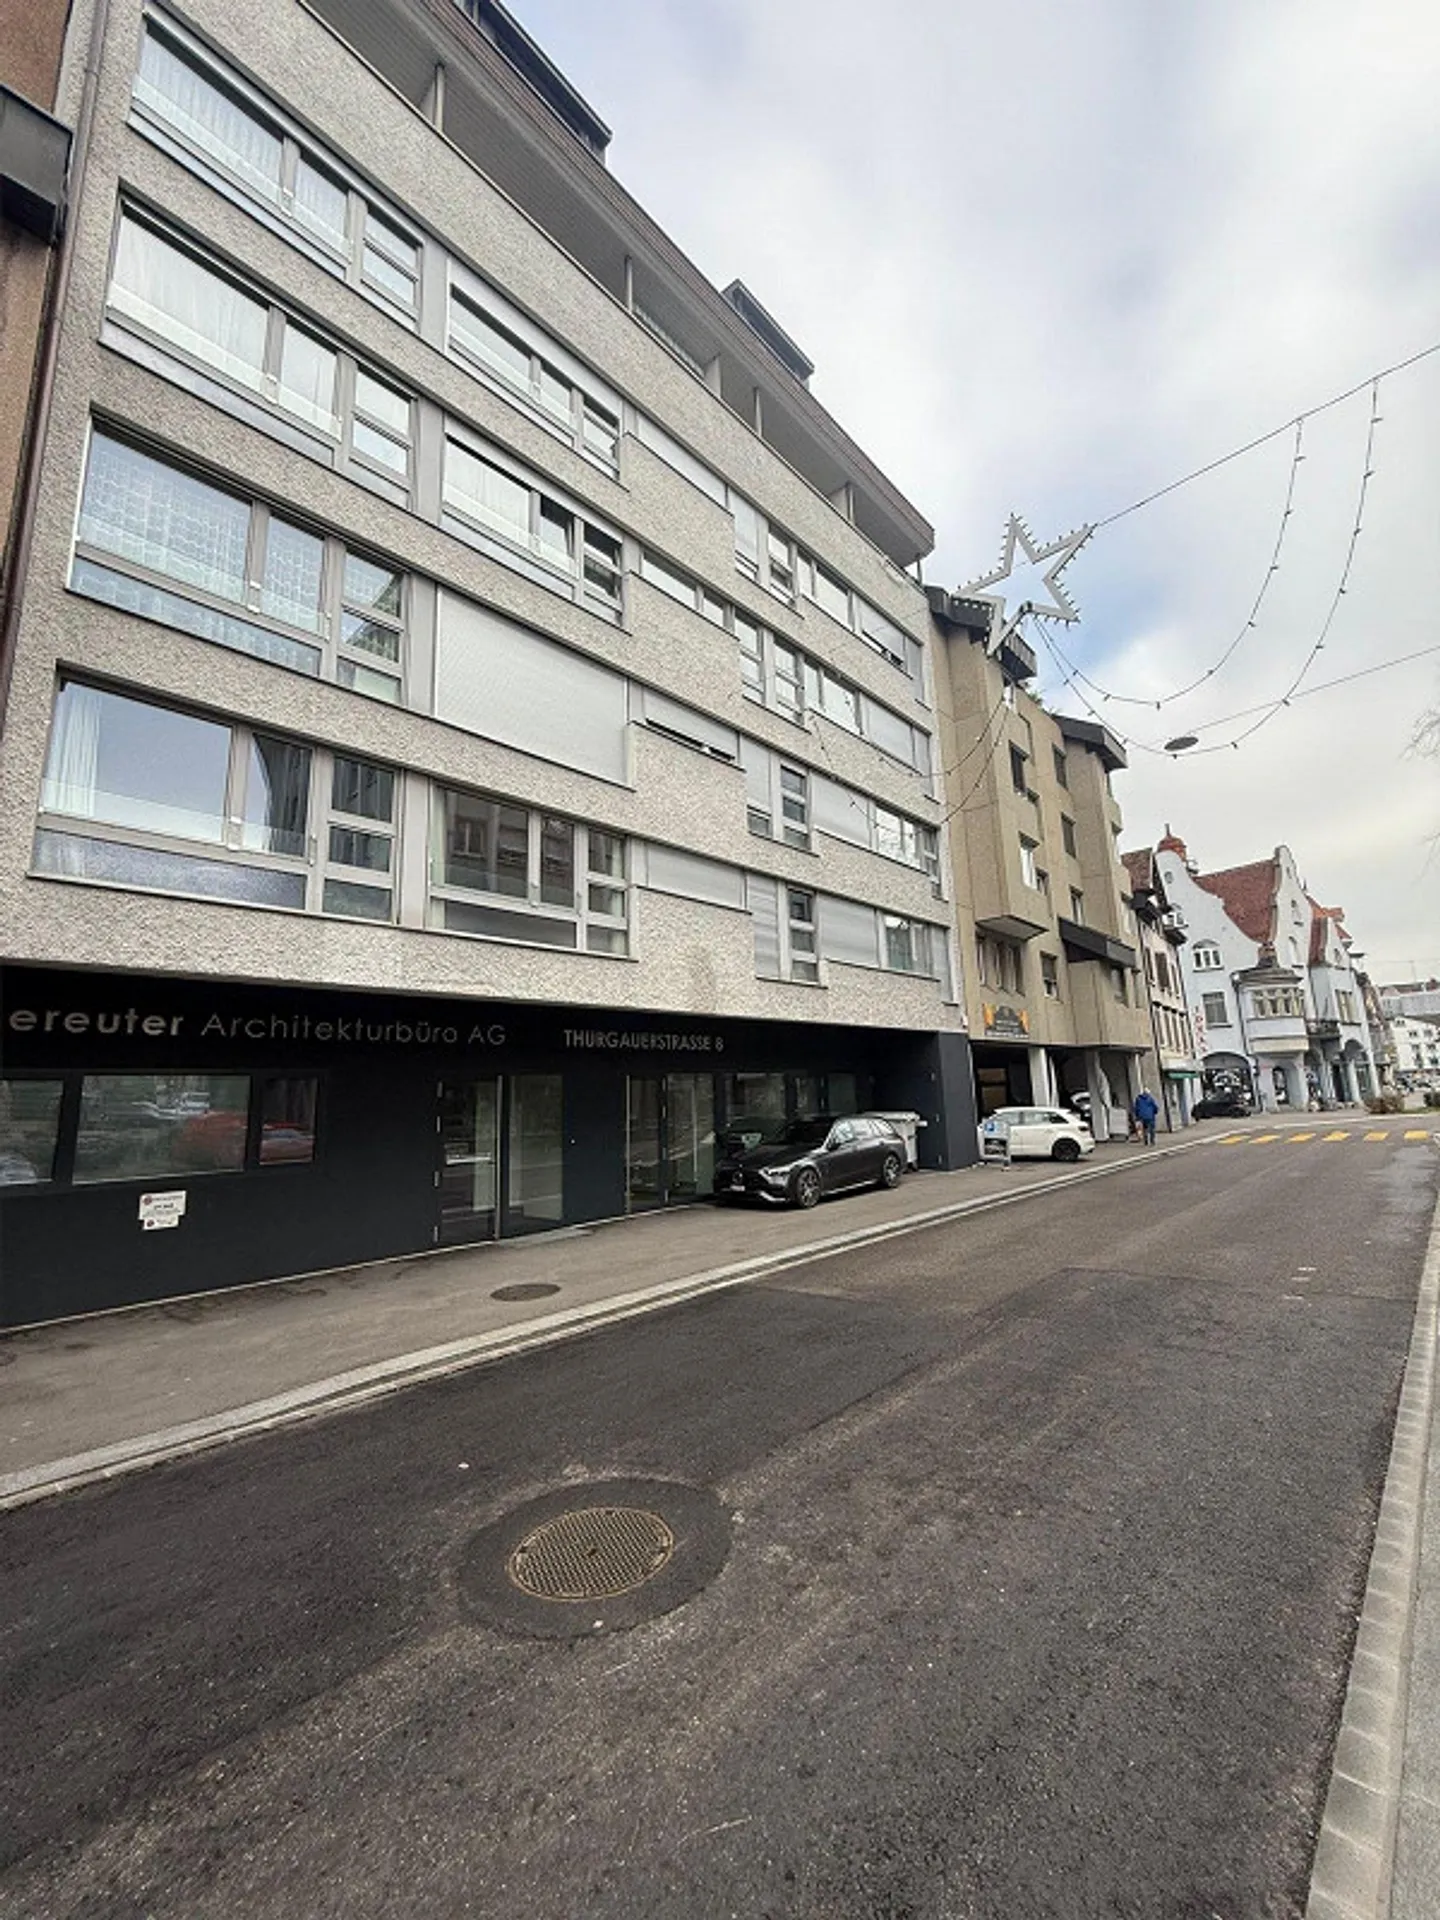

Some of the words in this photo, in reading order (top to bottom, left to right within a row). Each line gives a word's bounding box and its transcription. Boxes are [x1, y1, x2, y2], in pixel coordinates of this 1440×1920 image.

[8, 1007, 185, 1036] ereuter
[200, 1011, 459, 1043] Architekturbüro
[467, 1023, 507, 1046] AG
[563, 1028, 712, 1051] THURGAUERSTRASSE
[715, 1035, 725, 1052] 8
